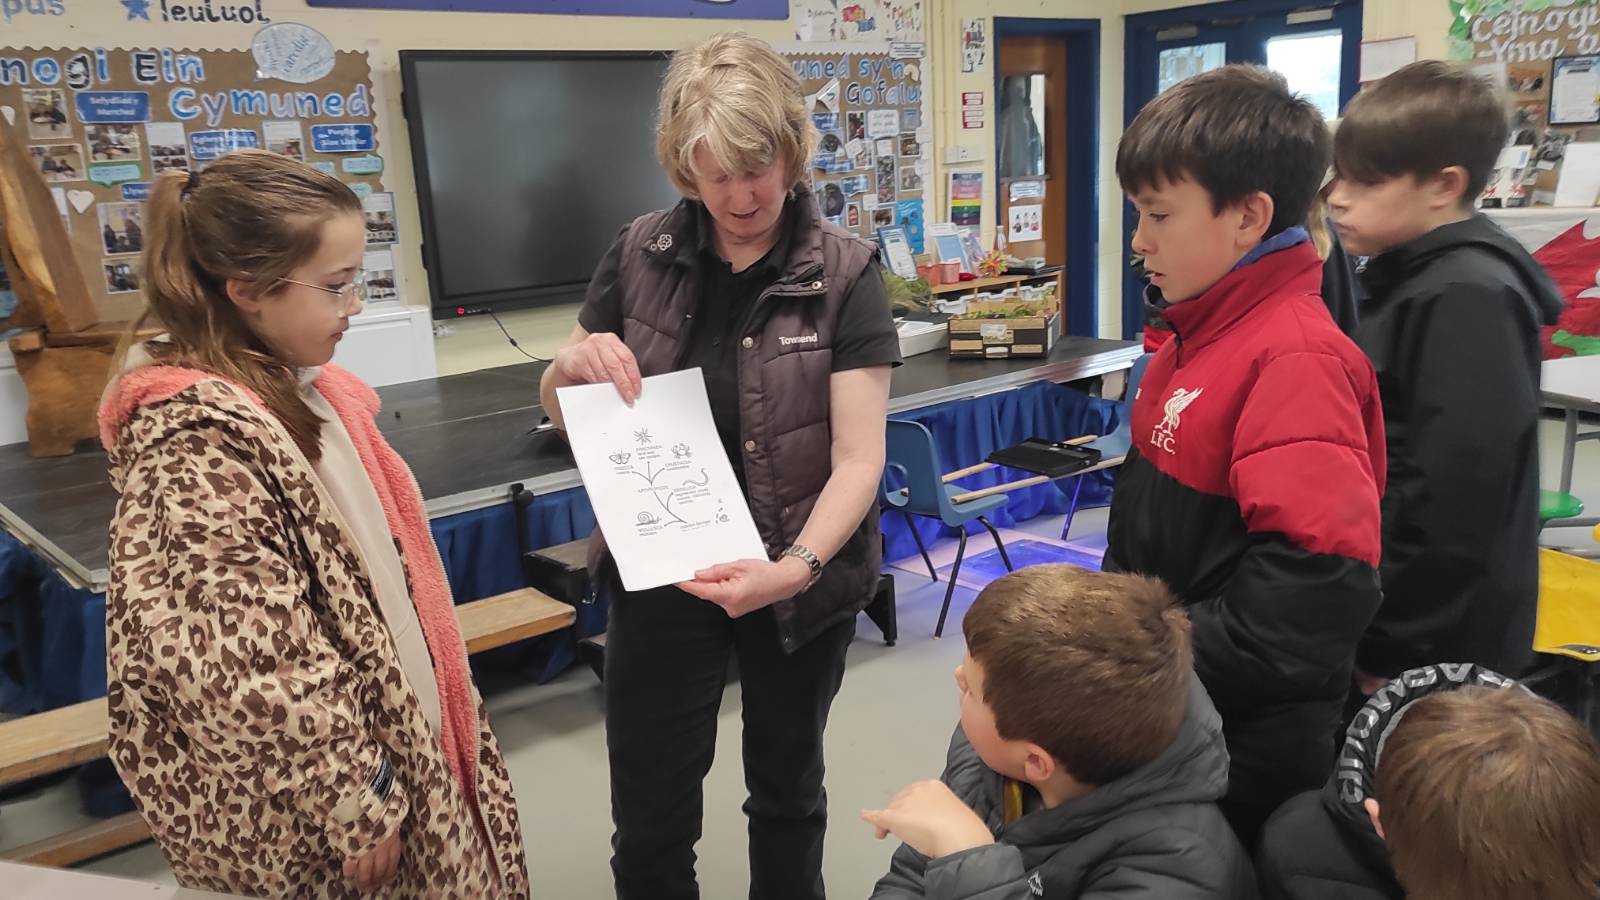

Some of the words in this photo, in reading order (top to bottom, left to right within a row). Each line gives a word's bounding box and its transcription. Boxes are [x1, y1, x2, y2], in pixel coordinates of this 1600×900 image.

[0, 48, 108, 89] nogi
[135, 50, 205, 82] Ein
[170, 86, 369, 125] Cymuned
[846, 80, 920, 104] Gofalu
[778, 332, 818, 346] Townend
